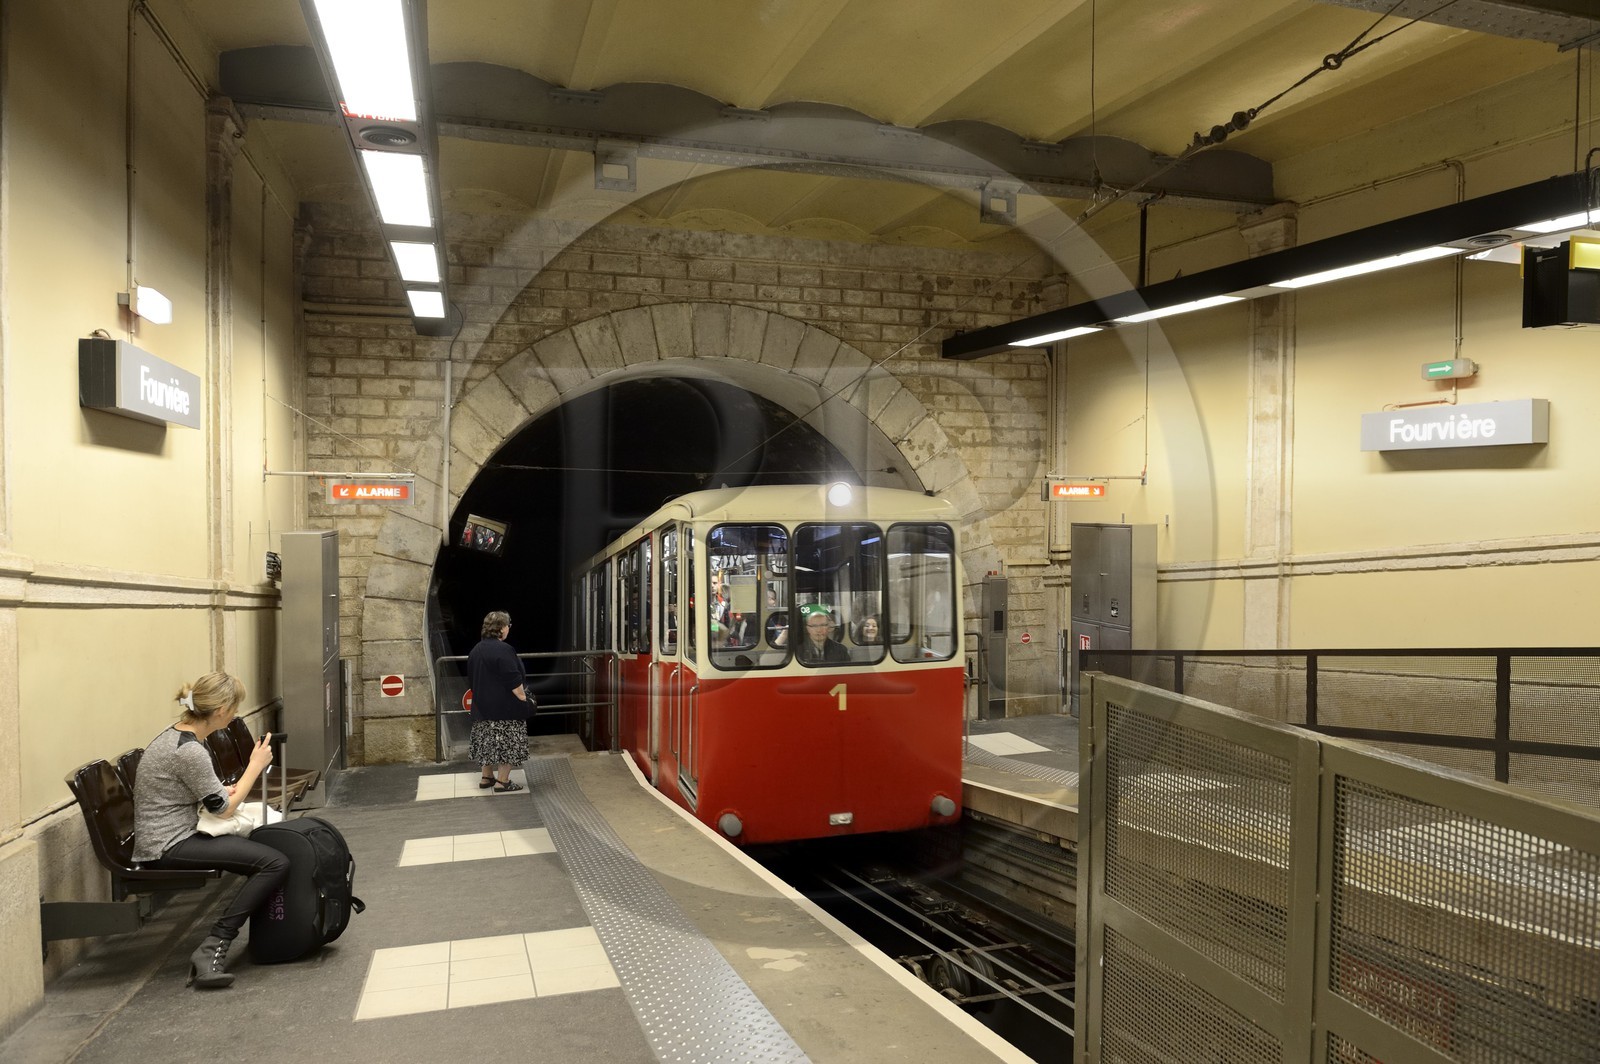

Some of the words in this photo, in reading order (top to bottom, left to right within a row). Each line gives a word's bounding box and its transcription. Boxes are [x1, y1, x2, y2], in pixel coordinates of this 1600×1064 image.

[140, 364, 190, 416] Fourvière
[1389, 413, 1496, 443] Fourvière
[356, 487, 401, 497] ALARME
[1058, 486, 1090, 495] ALARME
[828, 683, 847, 711] 1
